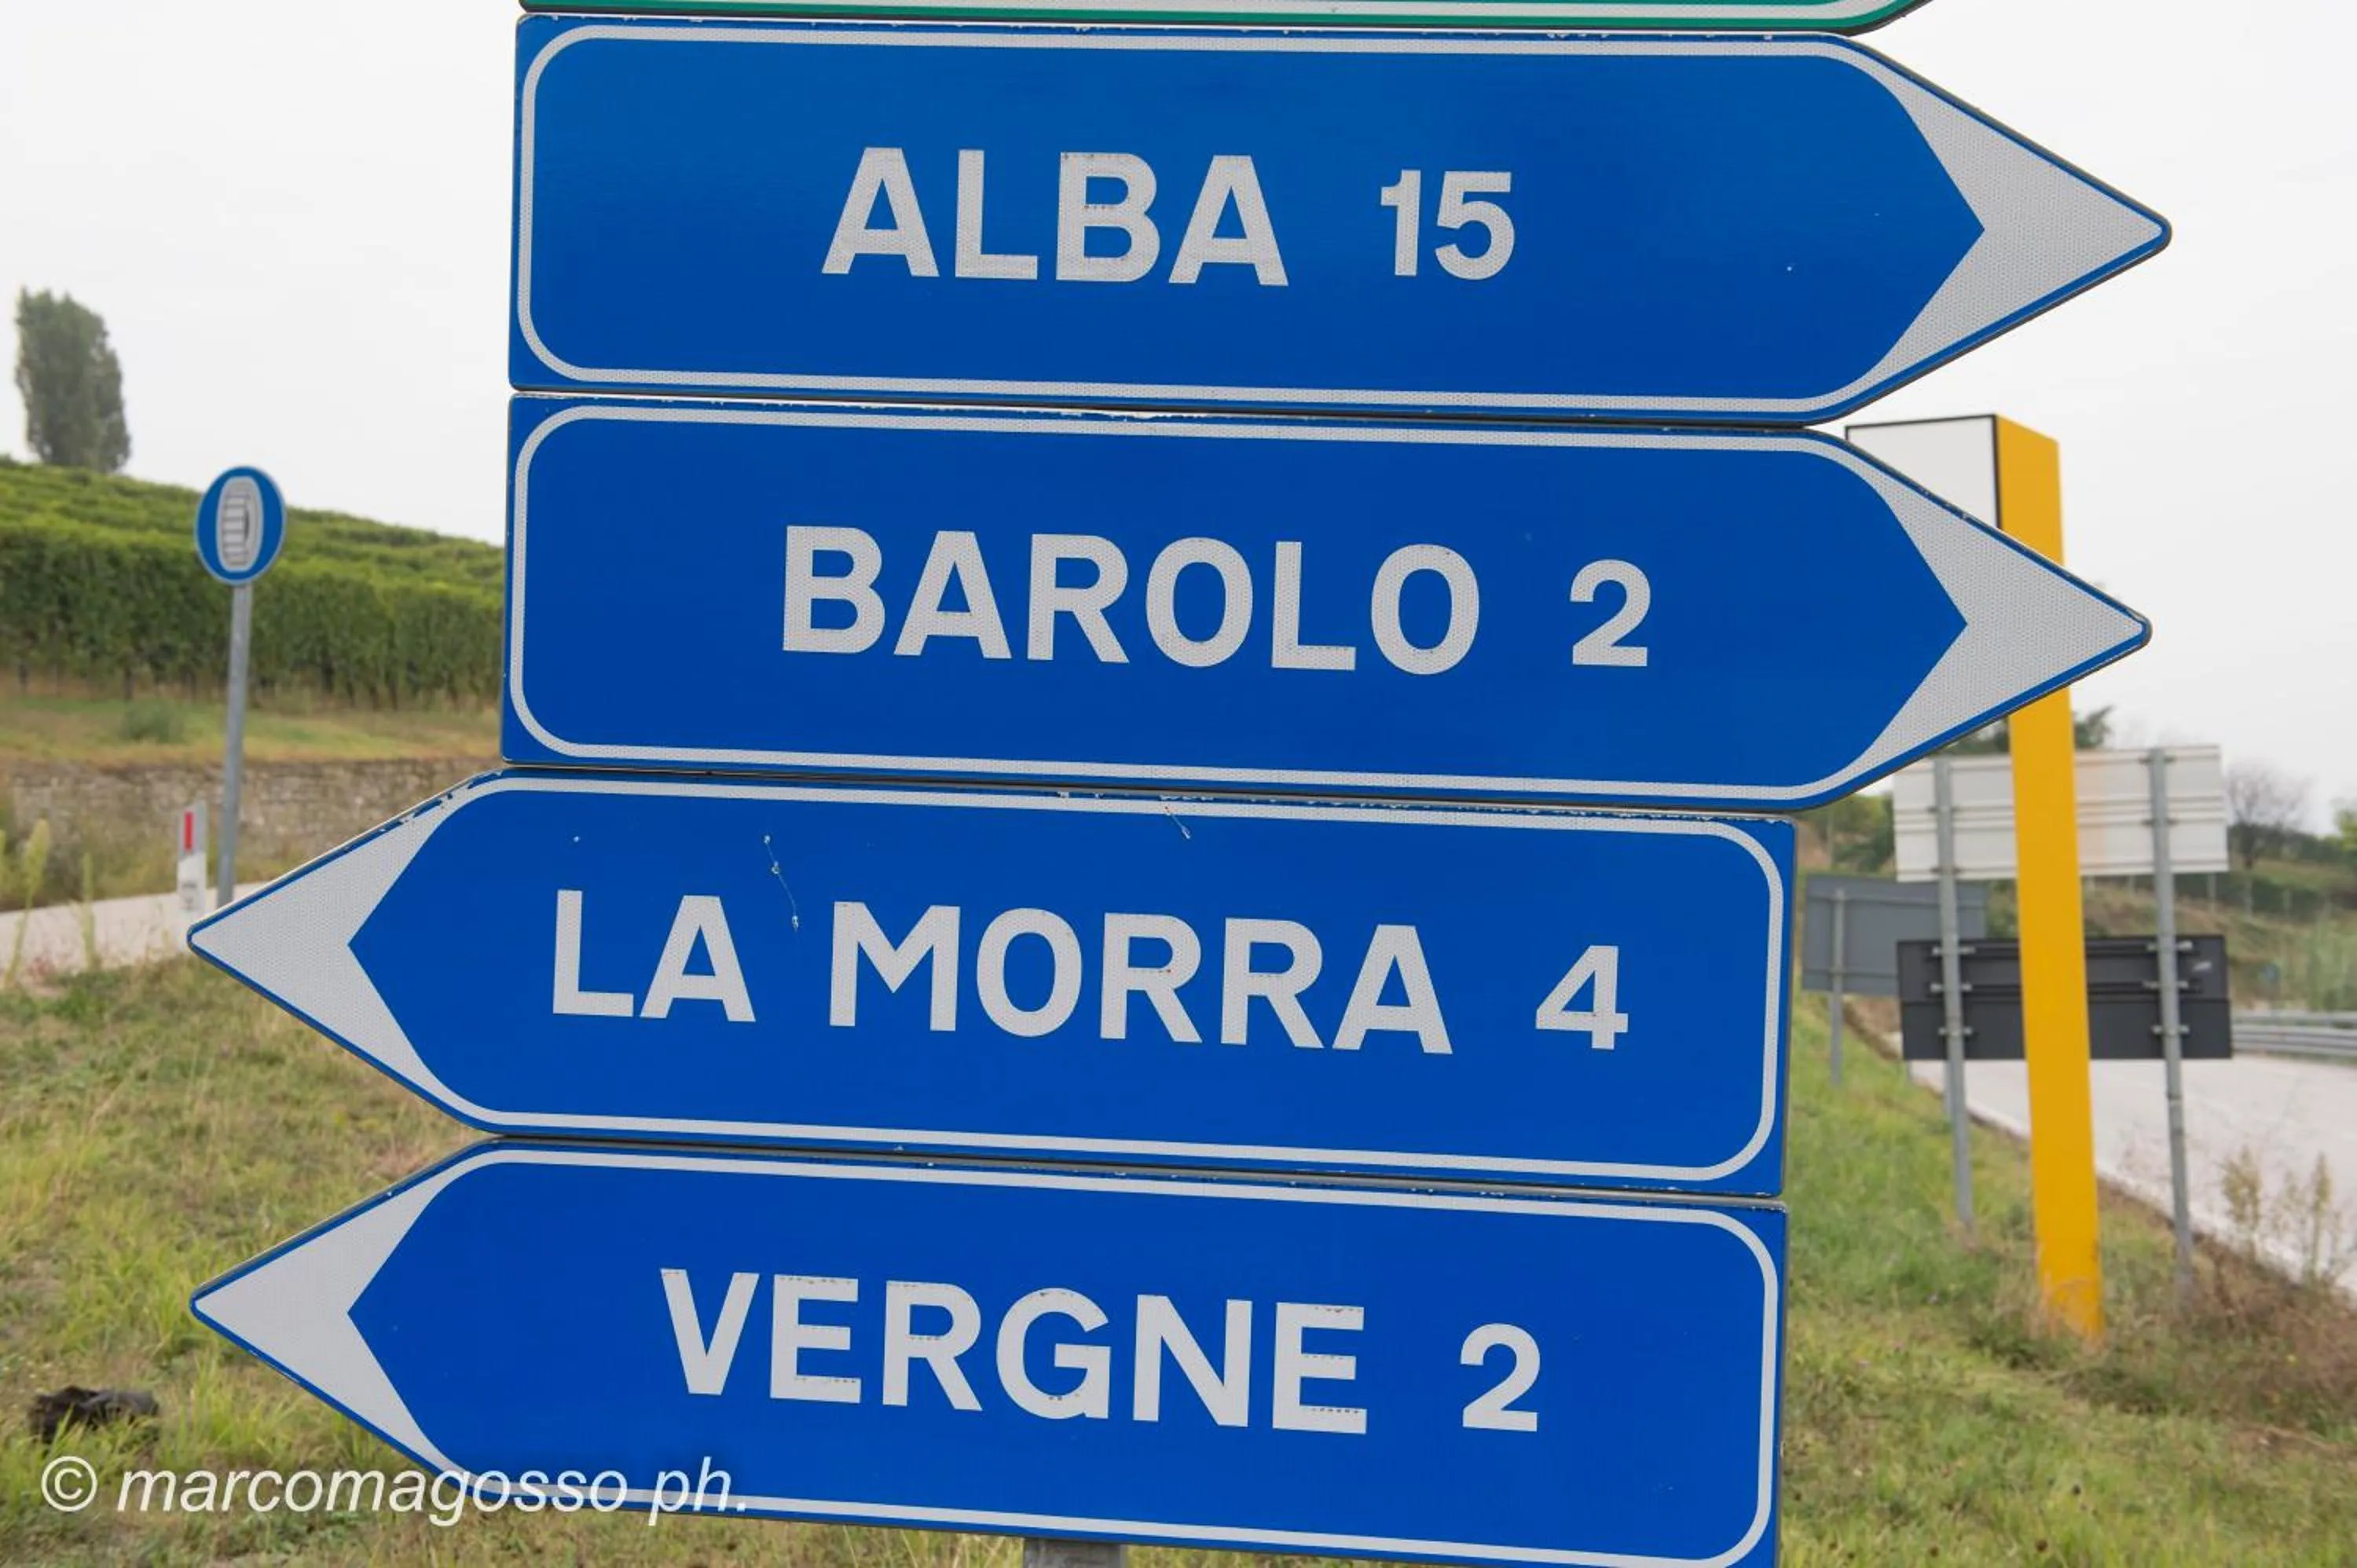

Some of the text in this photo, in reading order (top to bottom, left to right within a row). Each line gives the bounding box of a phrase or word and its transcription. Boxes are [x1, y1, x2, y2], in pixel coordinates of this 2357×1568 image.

[823, 148, 1514, 285] ALBA 15
[783, 526, 1650, 674] BAROLO 2
[553, 890, 1628, 1054] LA MORRA 4
[661, 1269, 1540, 1434] VERGNE 2
